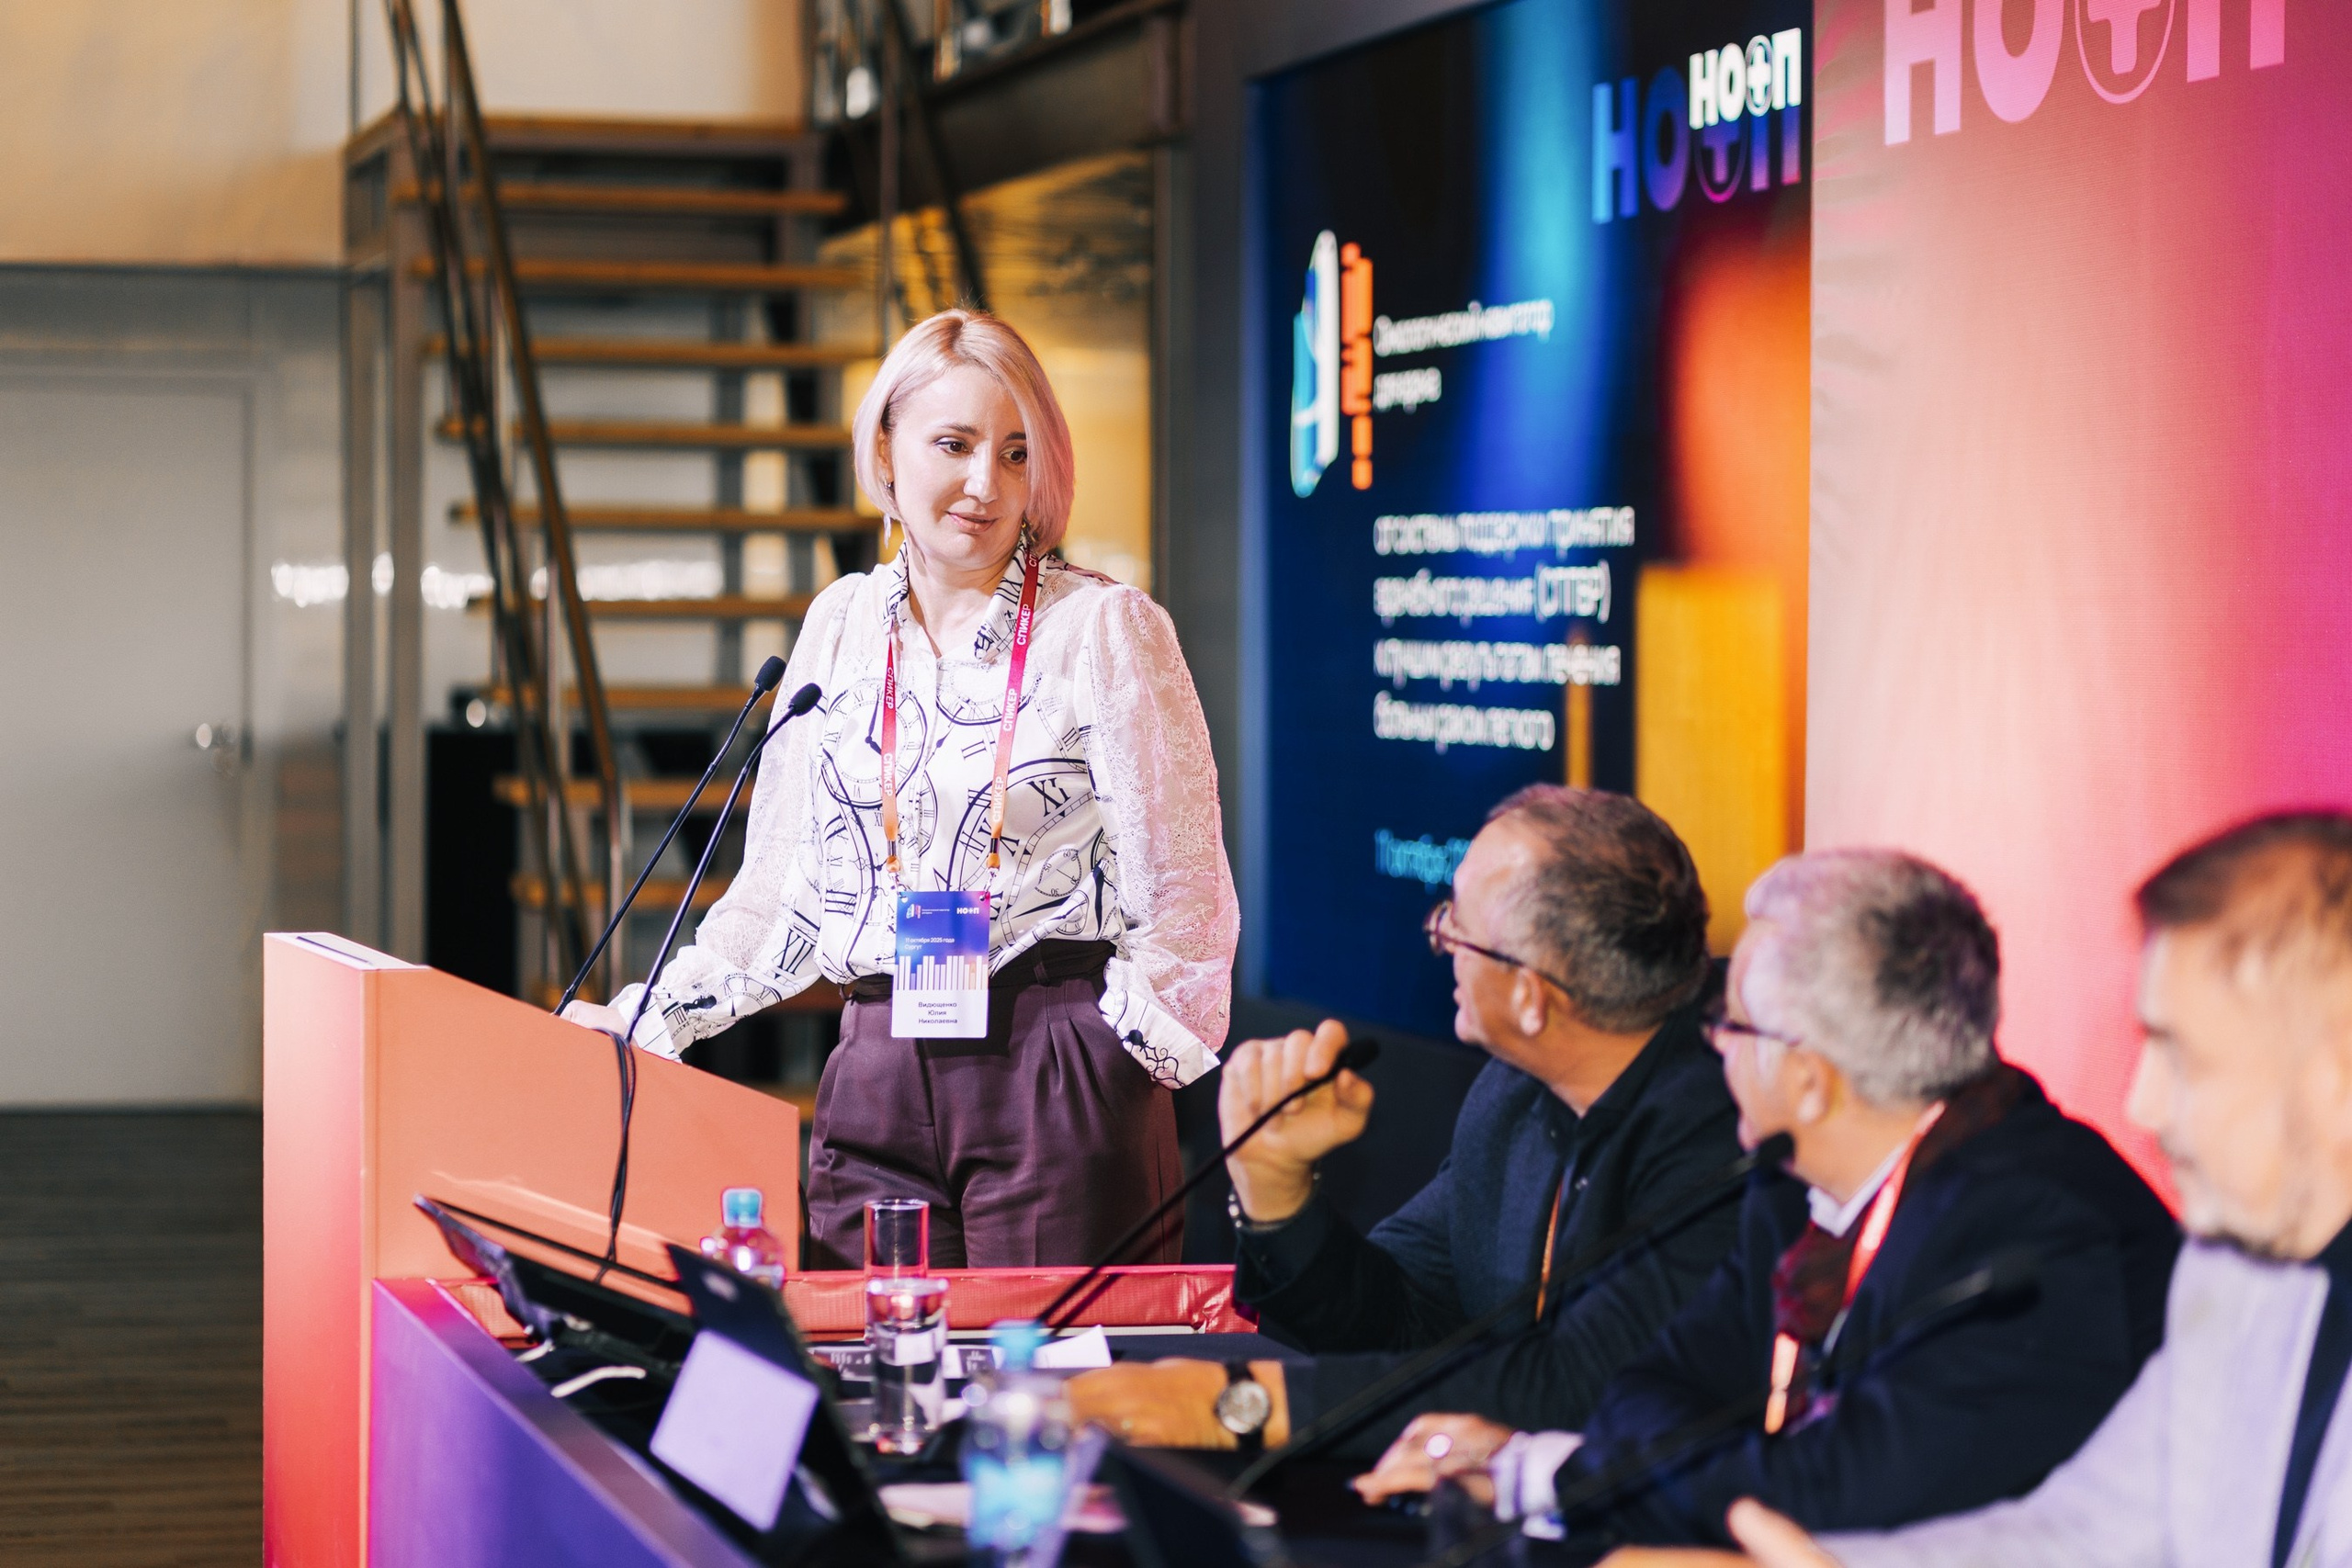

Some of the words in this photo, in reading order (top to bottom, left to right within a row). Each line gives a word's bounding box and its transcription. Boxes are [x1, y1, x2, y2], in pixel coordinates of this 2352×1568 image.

[1016, 604, 1031, 646] СПИКЕР
[887, 666, 895, 709] СПИКЕР
[1002, 688, 1018, 732] СПИКЕР
[883, 752, 894, 796] СПИКЕР
[992, 776, 1004, 823] СПИКЕР
